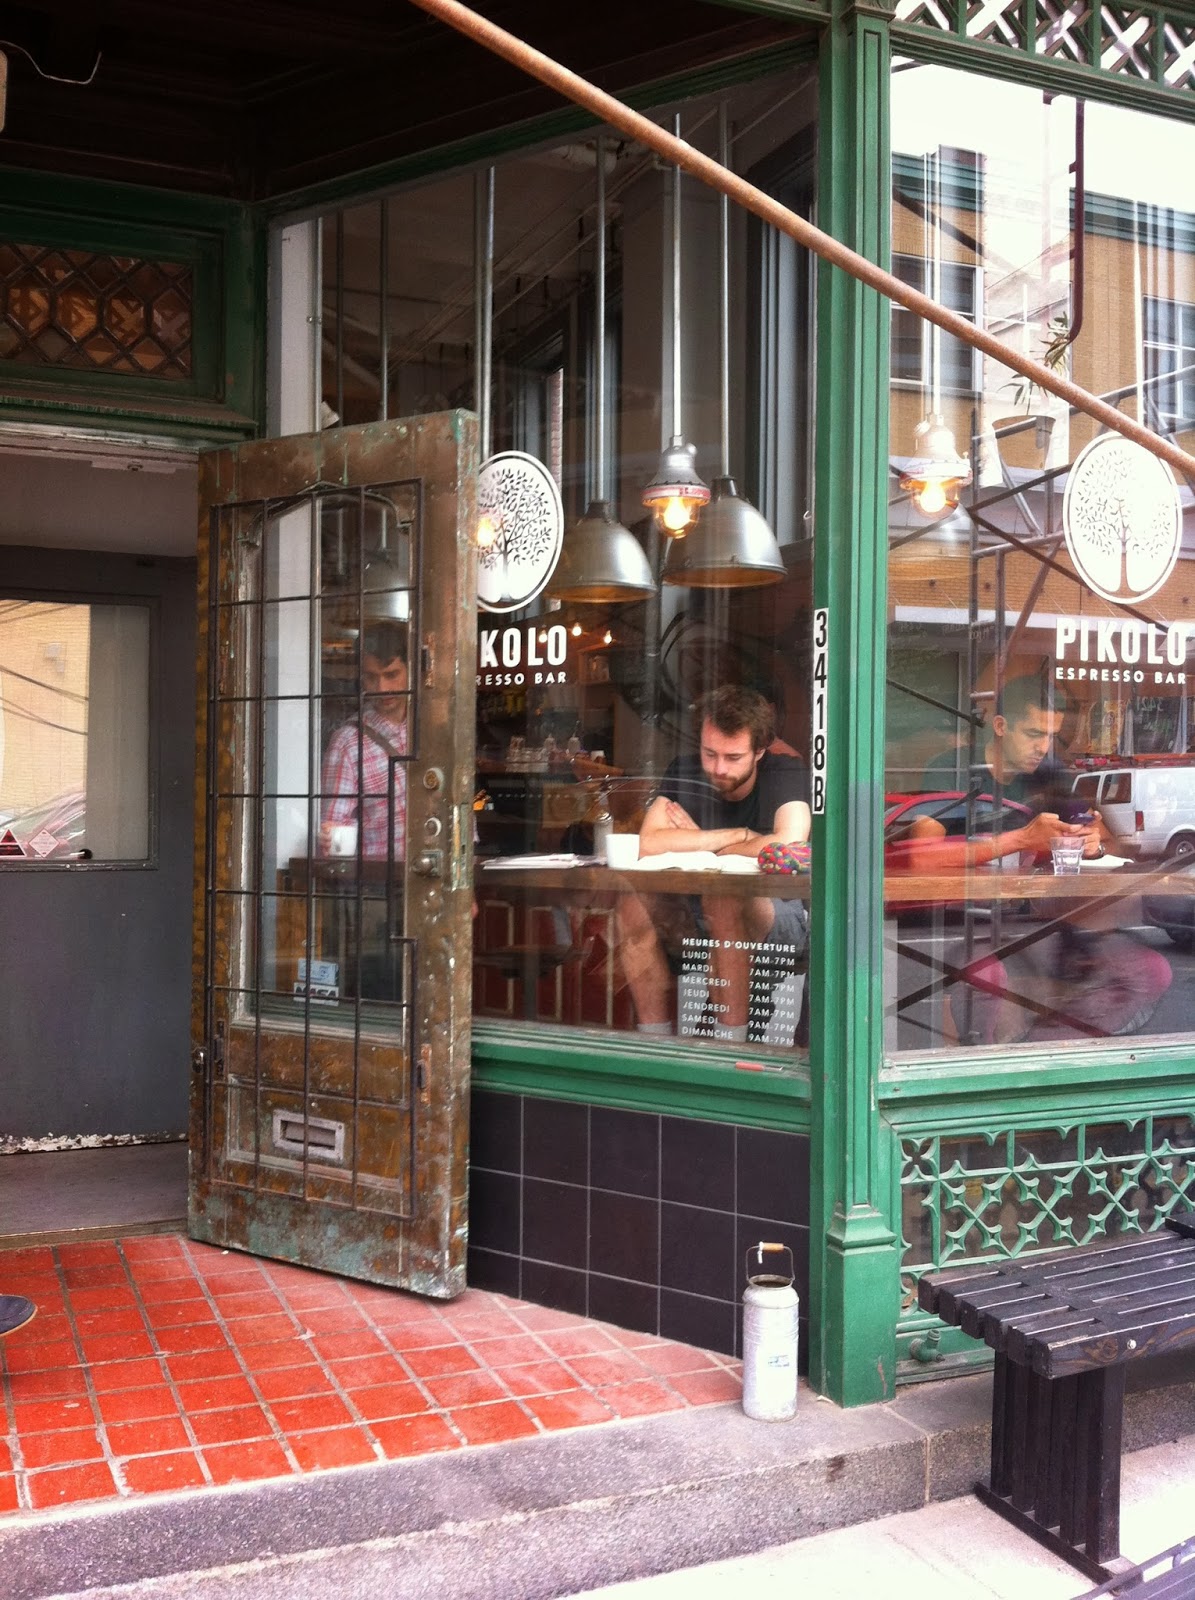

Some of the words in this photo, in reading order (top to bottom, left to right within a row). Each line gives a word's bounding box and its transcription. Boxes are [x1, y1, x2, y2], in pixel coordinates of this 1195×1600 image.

[480, 625, 567, 668] KOLO
[1055, 617, 1187, 666] PIKOLO
[475, 673, 525, 686] RESSO
[534, 671, 567, 684] BAR
[1055, 667, 1145, 683] ESPRESSO
[1154, 671, 1187, 685] BAR
[814, 611, 827, 812] 3418B
[682, 938, 720, 948] HEURES
[724, 940, 796, 953] D'OUVERTURE
[682, 950, 711, 960] LUNDI
[681, 963, 713, 973] MARDI
[681, 976, 731, 987] MERCREDI
[681, 1013, 718, 1025] SAMEDI
[682, 1026, 733, 1040] DIMANCHE
